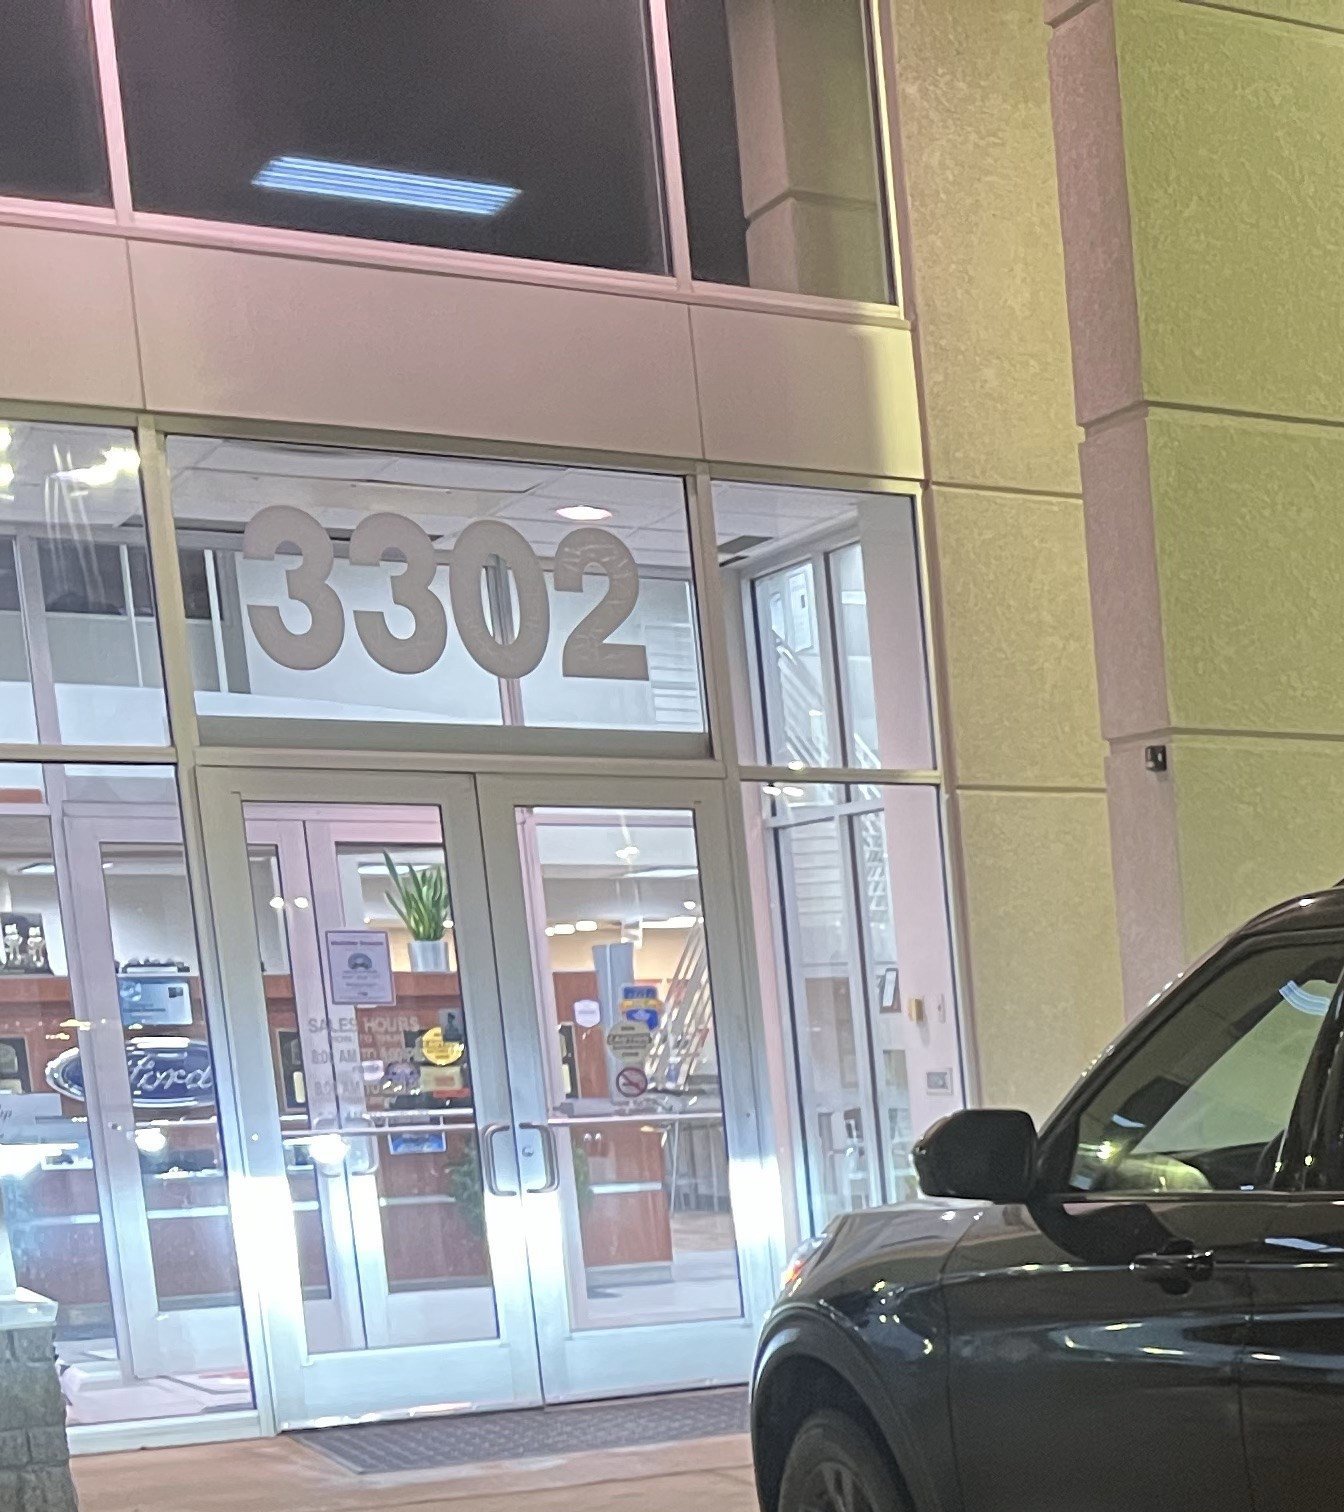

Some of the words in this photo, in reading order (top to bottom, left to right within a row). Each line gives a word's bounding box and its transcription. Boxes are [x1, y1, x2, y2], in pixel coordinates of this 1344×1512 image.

[244, 504, 650, 681] 3302
[308, 1018, 356, 1034] SALES
[362, 1016, 420, 1032] HOURS
